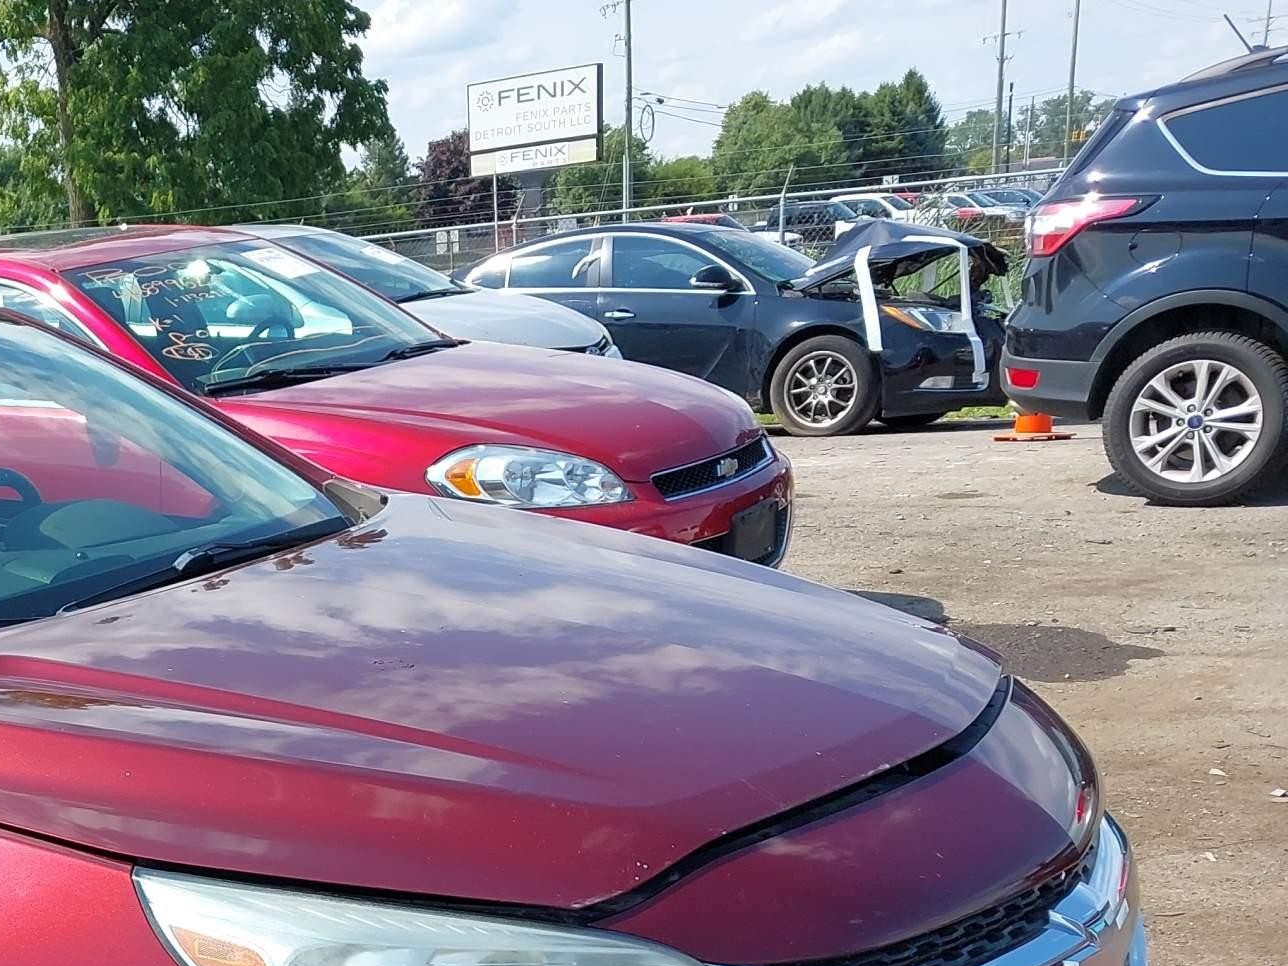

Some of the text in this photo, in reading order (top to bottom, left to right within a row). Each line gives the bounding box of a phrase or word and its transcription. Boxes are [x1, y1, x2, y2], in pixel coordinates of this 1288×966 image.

[498, 77, 587, 107] FENIX
[516, 102, 592, 122] FENIX PARTS
[474, 115, 592, 141] DETROIT SOUTH LLC
[510, 144, 566, 163] FENIX
